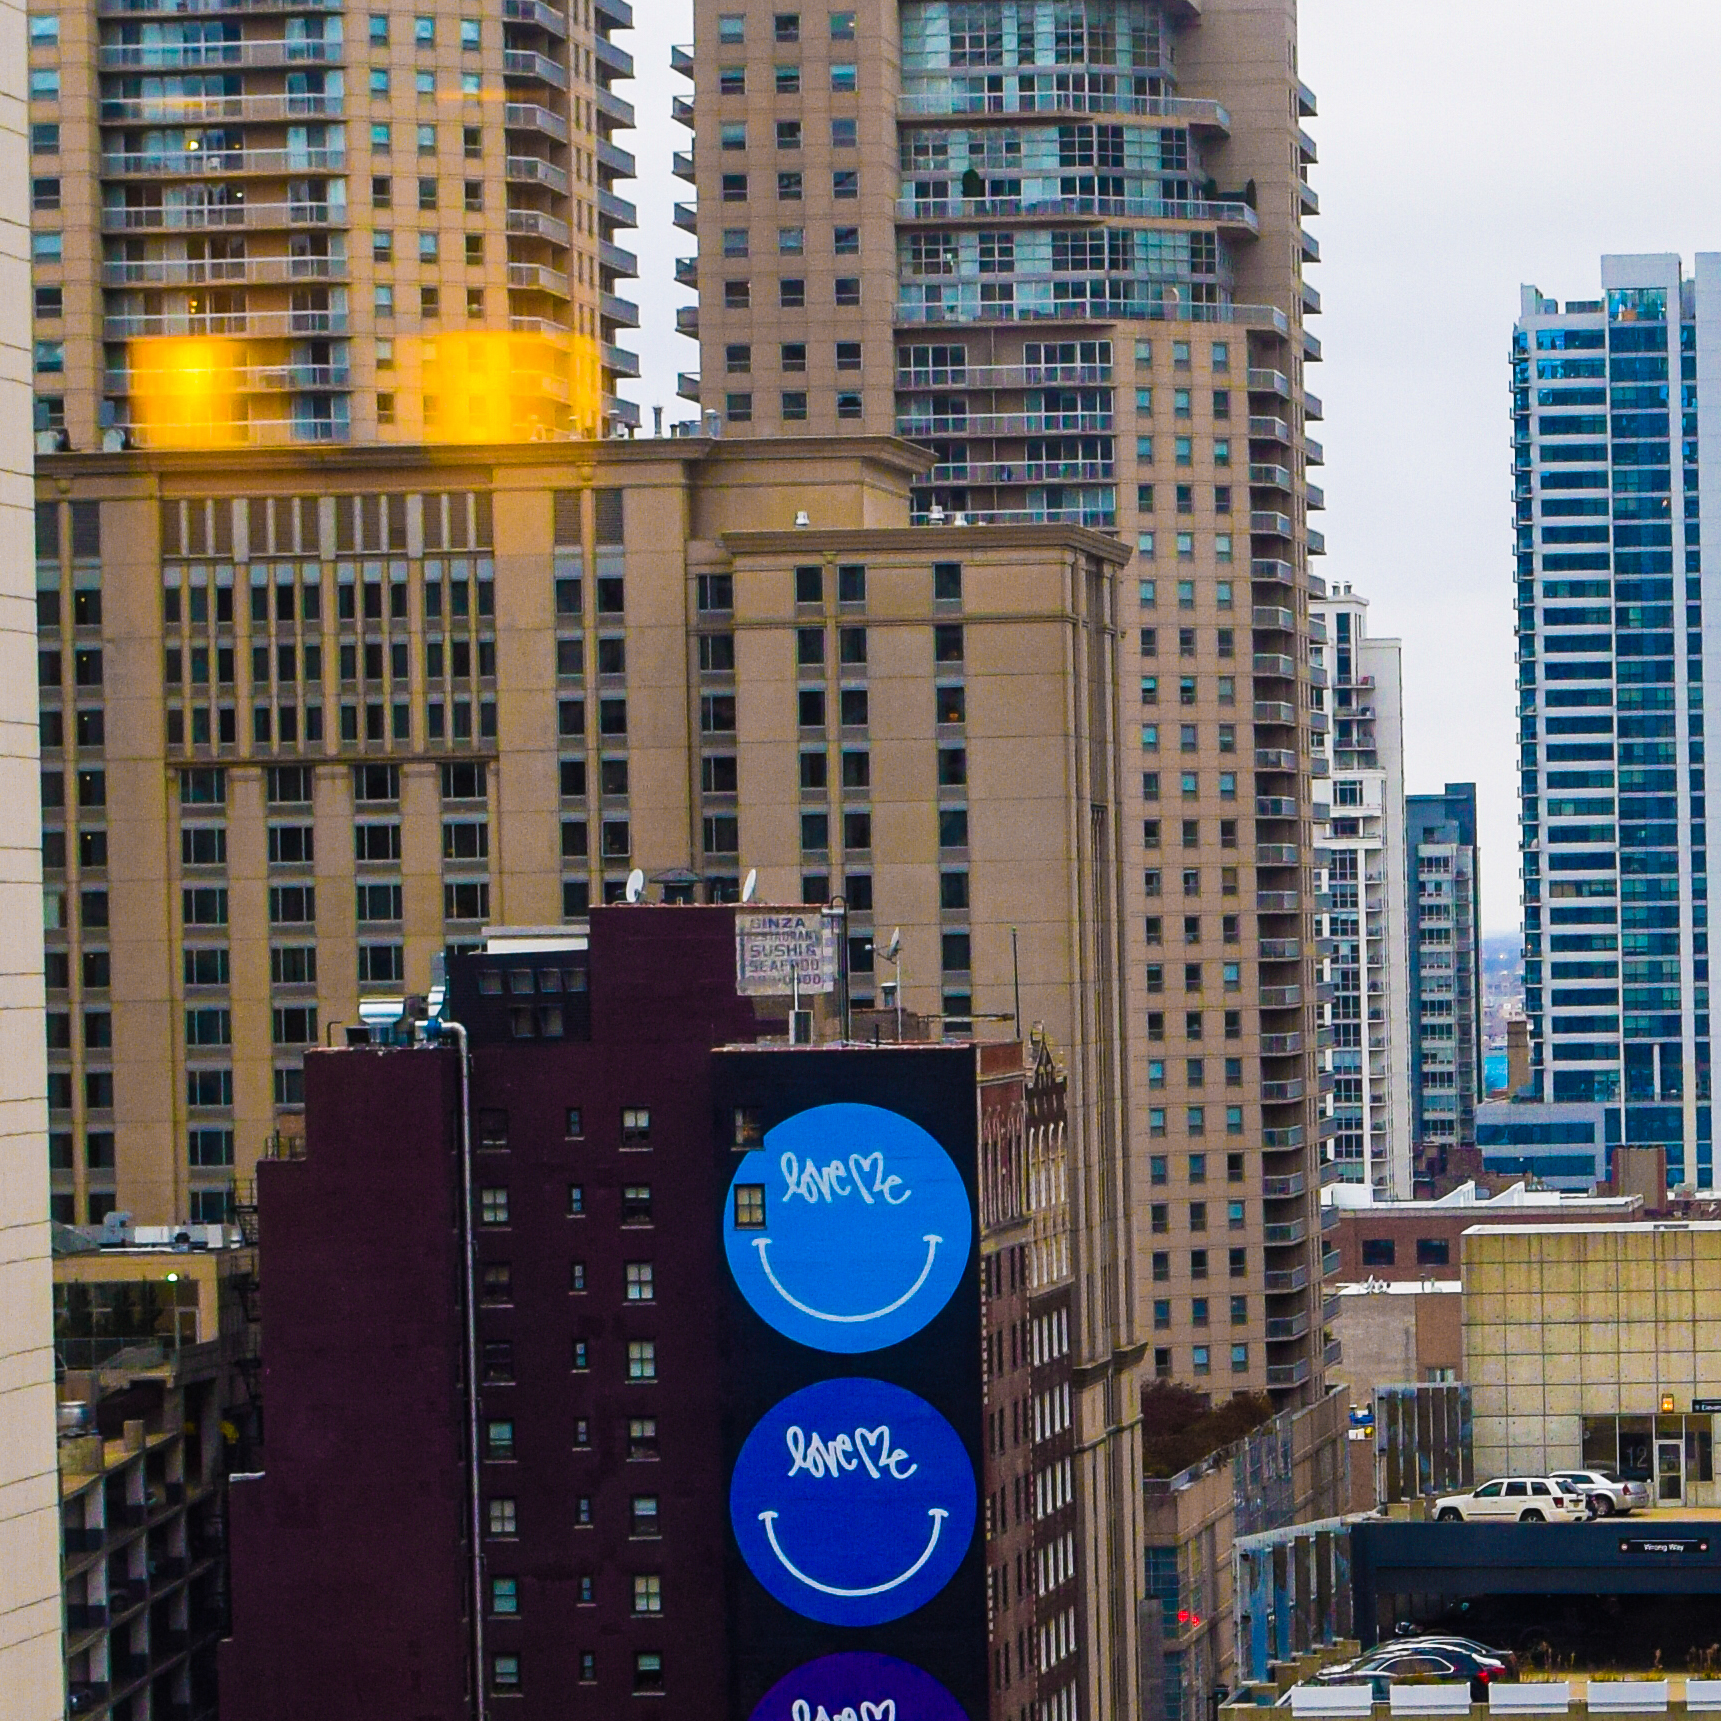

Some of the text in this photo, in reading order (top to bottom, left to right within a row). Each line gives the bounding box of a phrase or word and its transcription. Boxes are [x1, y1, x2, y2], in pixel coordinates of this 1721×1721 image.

[750, 944, 803, 958] SUSHI
[1626, 1445, 1648, 1468] 12
[1644, 1544, 1685, 1553] Wrong Way
